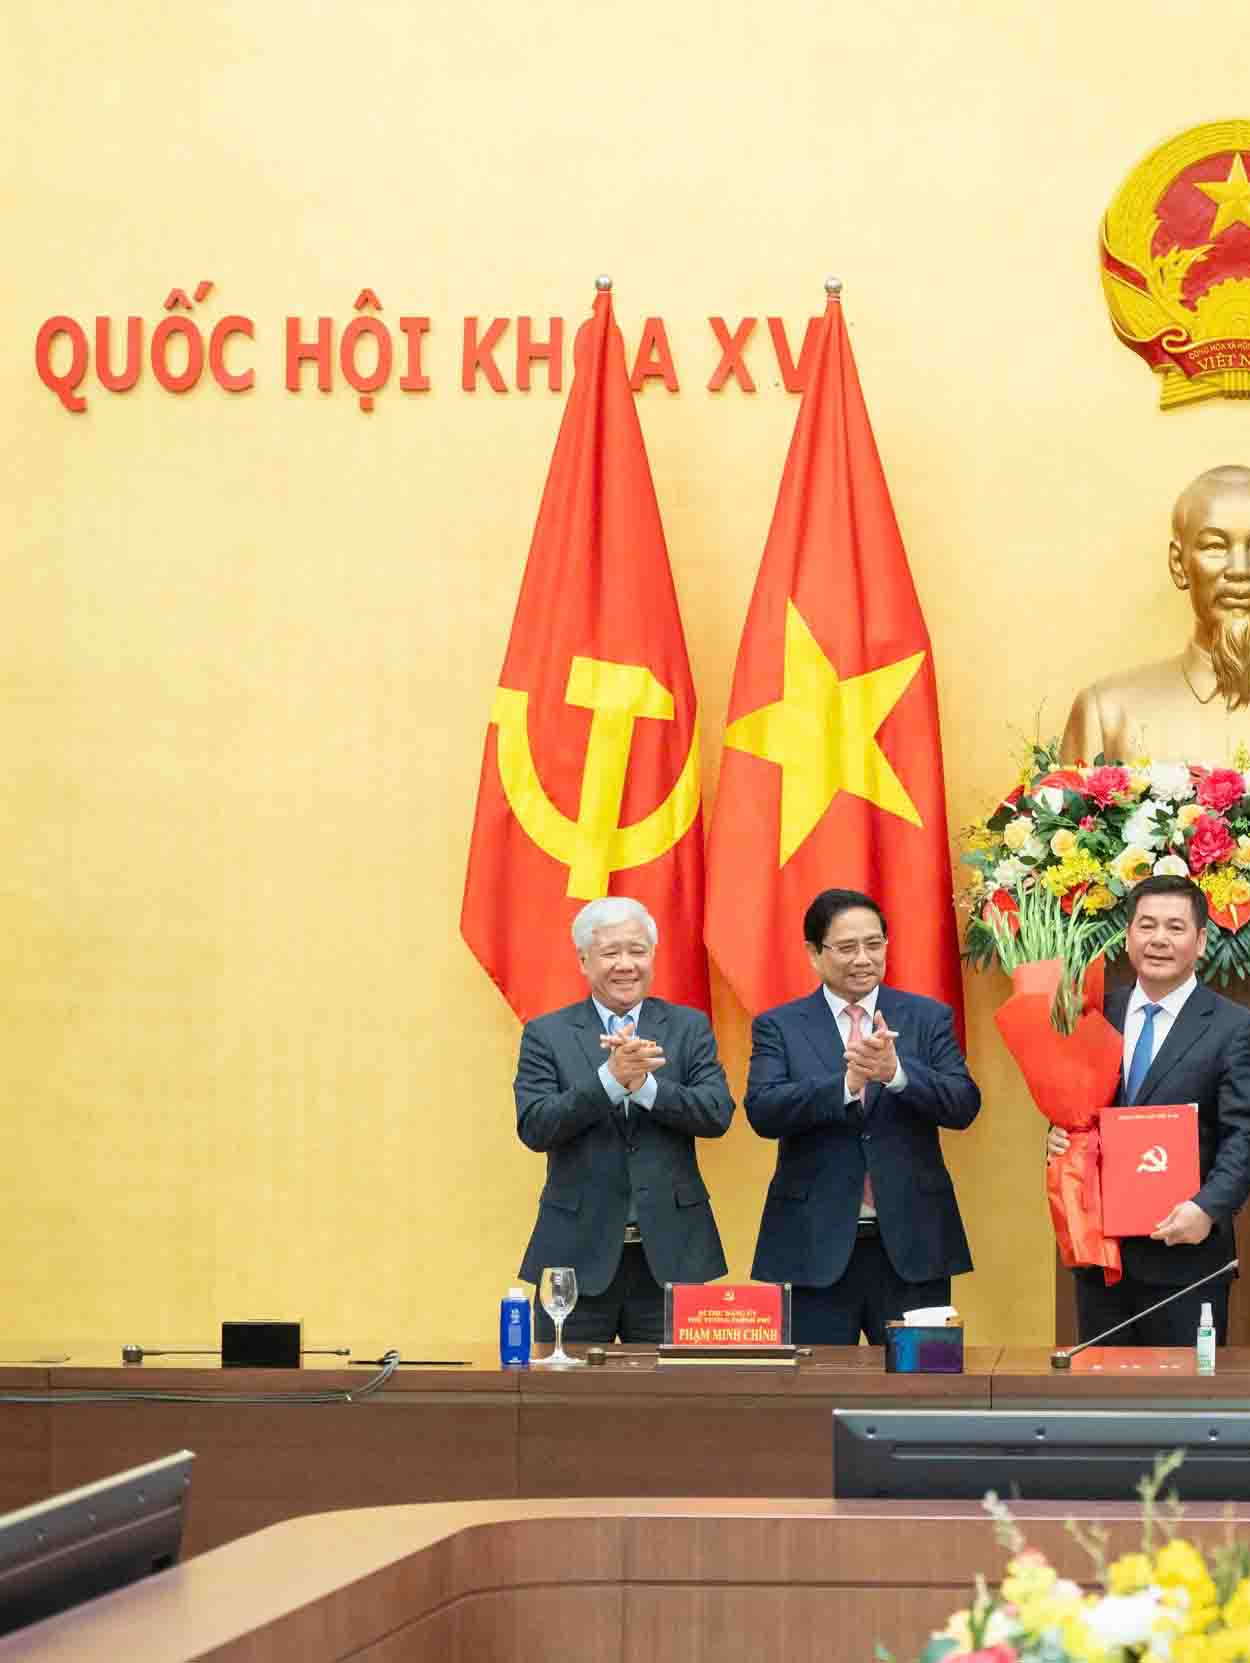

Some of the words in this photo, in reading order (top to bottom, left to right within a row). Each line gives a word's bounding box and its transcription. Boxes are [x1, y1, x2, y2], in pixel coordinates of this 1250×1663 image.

[35, 281, 255, 413] QUỐC
[285, 288, 432, 412] HỘI
[706, 316, 826, 393] XV
[679, 1327, 710, 1344] PHẠM
[712, 1327, 741, 1342] MINH
[743, 1325, 778, 1342] CHÍNH
